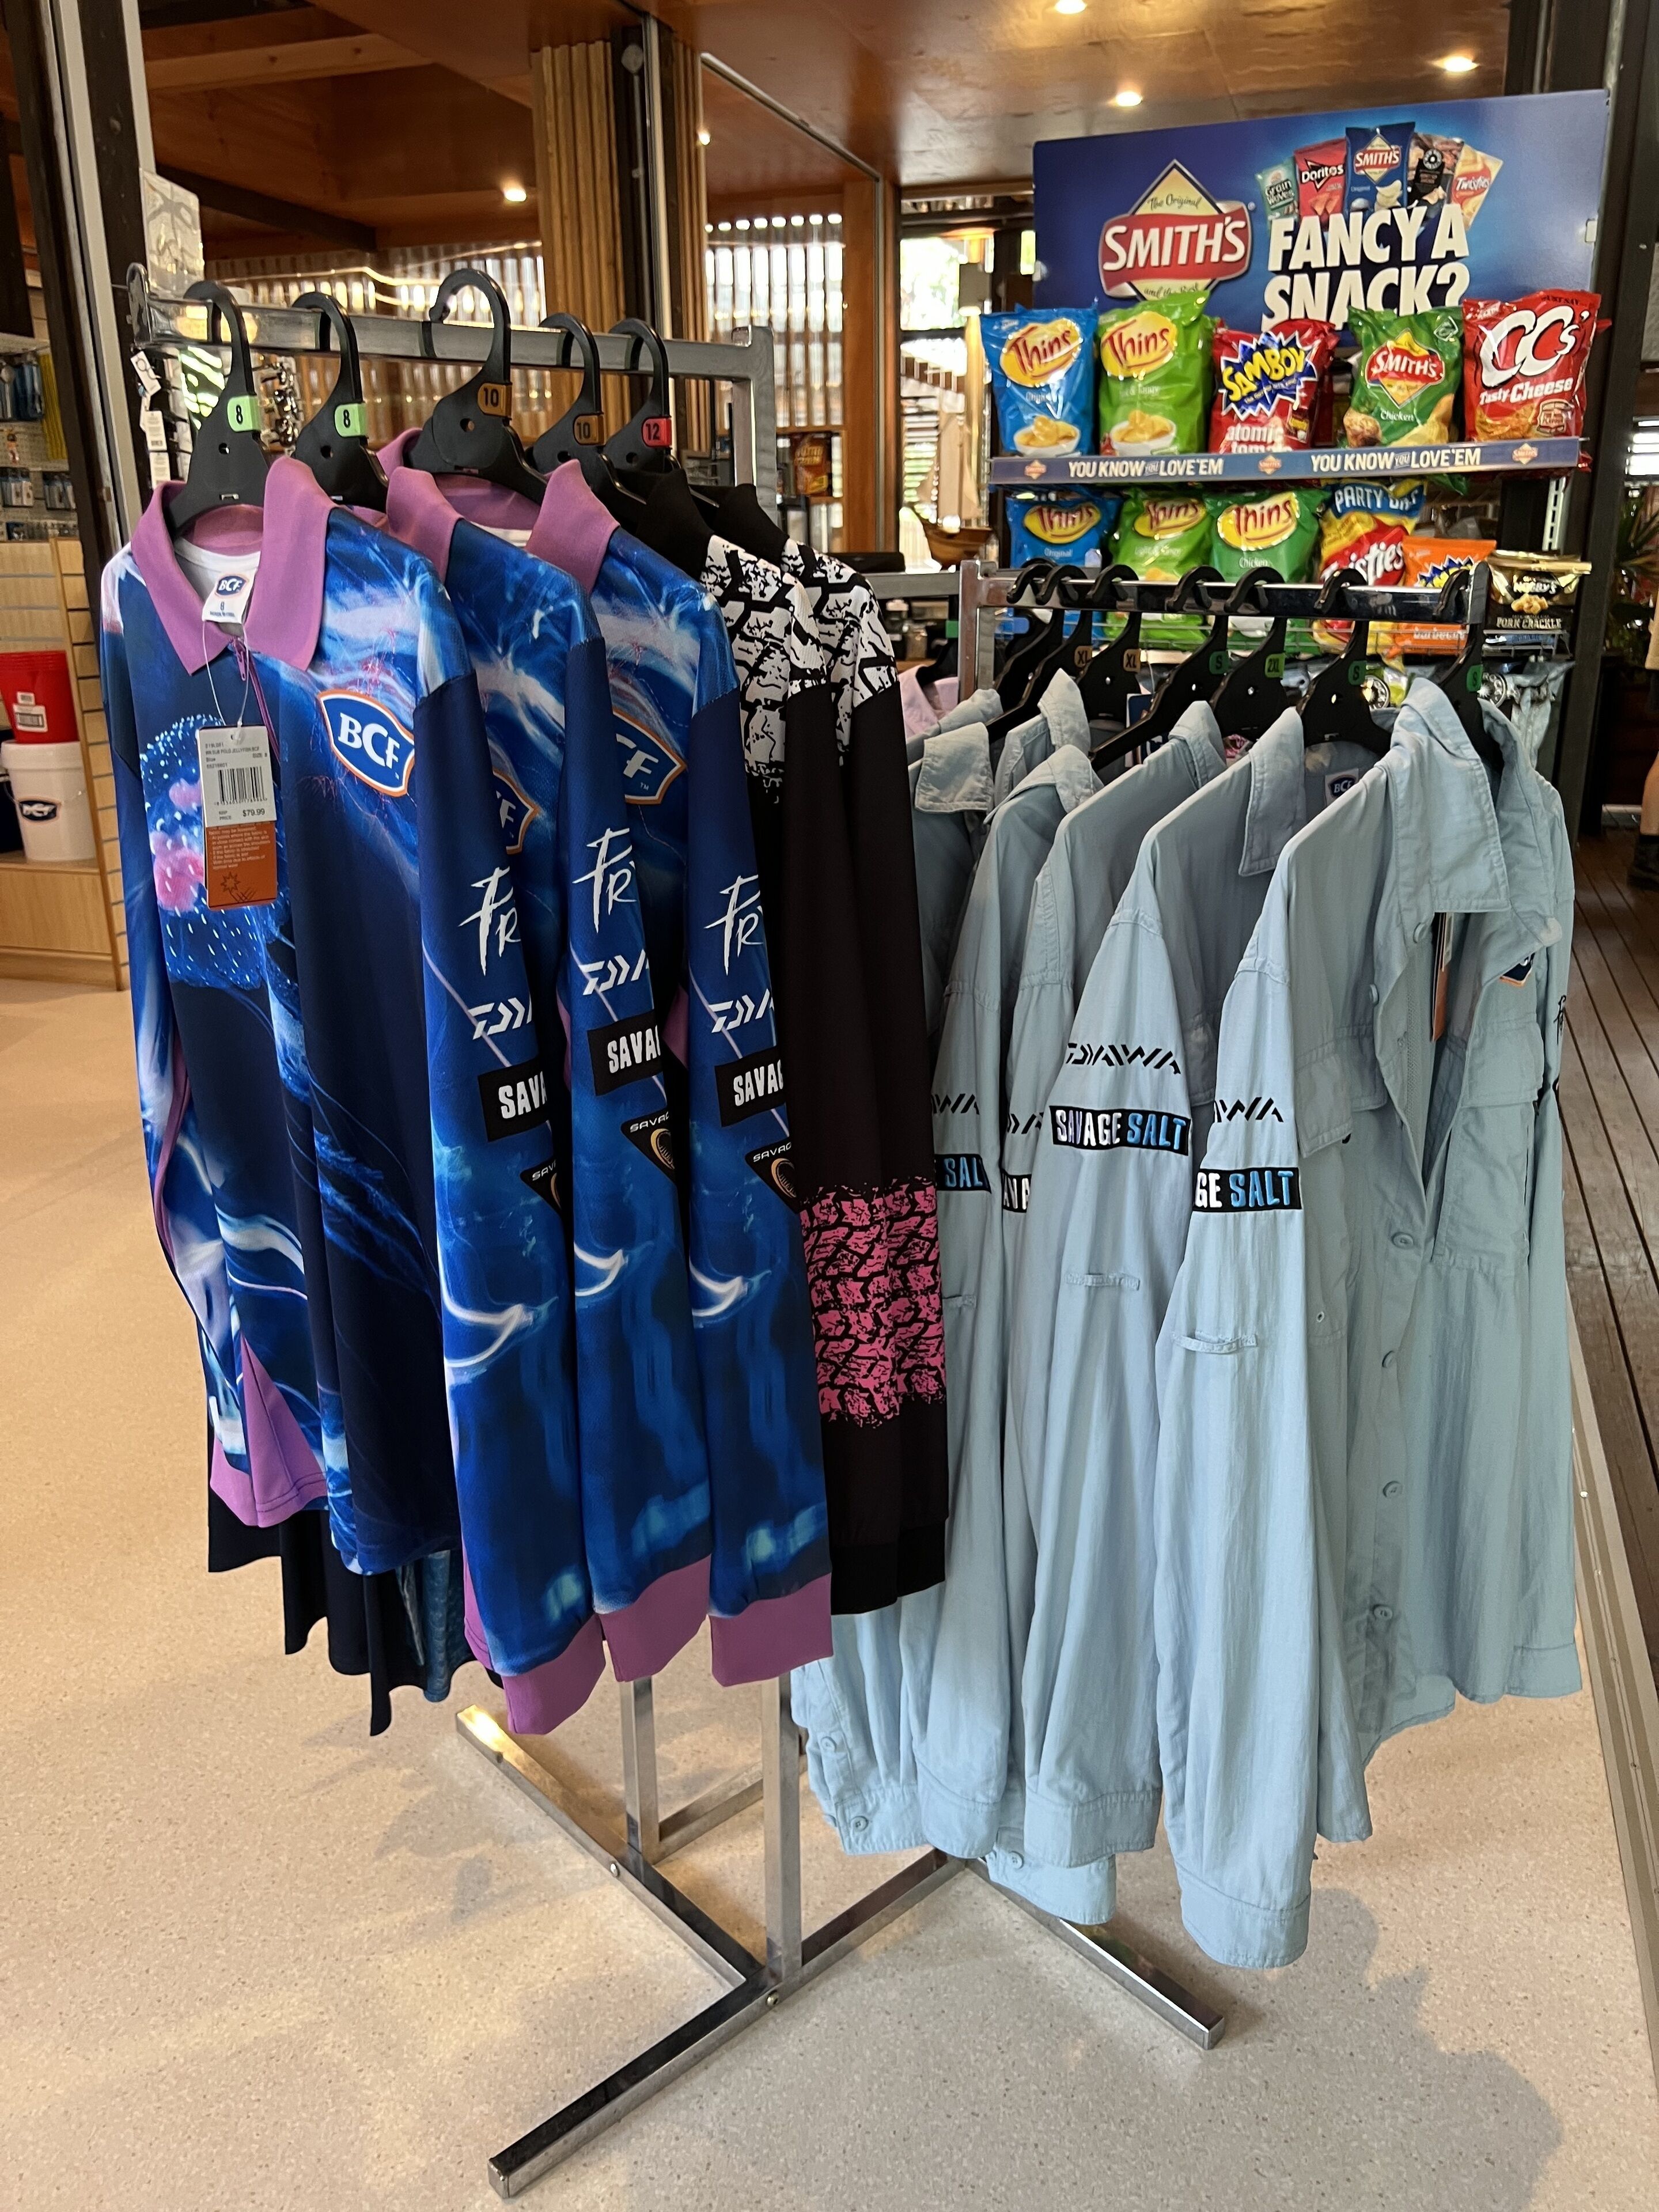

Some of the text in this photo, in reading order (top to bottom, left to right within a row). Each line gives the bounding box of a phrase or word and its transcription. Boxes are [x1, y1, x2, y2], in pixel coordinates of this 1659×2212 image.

[1301, 164, 1344, 184] Doritos
[1165, 193, 1203, 210] Original
[1103, 216, 1246, 271] SMITH'S
[1268, 204, 1469, 271] FANCY A
[1261, 263, 1469, 332] SNACK?
[1008, 325, 1071, 374] Thins
[1102, 319, 1170, 369] Thins
[1222, 347, 1305, 402] SAMBOY
[1371, 351, 1438, 378] SMITH'S
[483, 387, 499, 407] 10
[1479, 377, 1574, 406] Tasty Cheese
[236, 406, 243, 424] 8
[343, 410, 350, 427] 8
[1380, 410, 1414, 422] Chicken
[577, 422, 590, 440] 10
[646, 422, 661, 441] 12
[1069, 461, 1097, 478] YOU
[1099, 460, 1146, 477] KNOW
[1311, 454, 1343, 472] YOU
[1344, 452, 1395, 471] KNOW
[1334, 486, 1383, 513] PARTY
[1233, 499, 1291, 537] Thins
[1239, 557, 1270, 568] Chicken
[218, 578, 243, 592] BCF
[1497, 615, 1562, 630] PORK CRACKLE
[1125, 653, 1137, 668] XL
[1215, 655, 1222, 670] S
[1353, 665, 1360, 678] S
[336, 712, 400, 770] BCF
[243, 808, 266, 817] $79.99
[1055, 1109, 1121, 1146] SAVAGE
[1127, 1112, 1187, 1150] SALT
[1229, 1171, 1294, 1207] SALT
